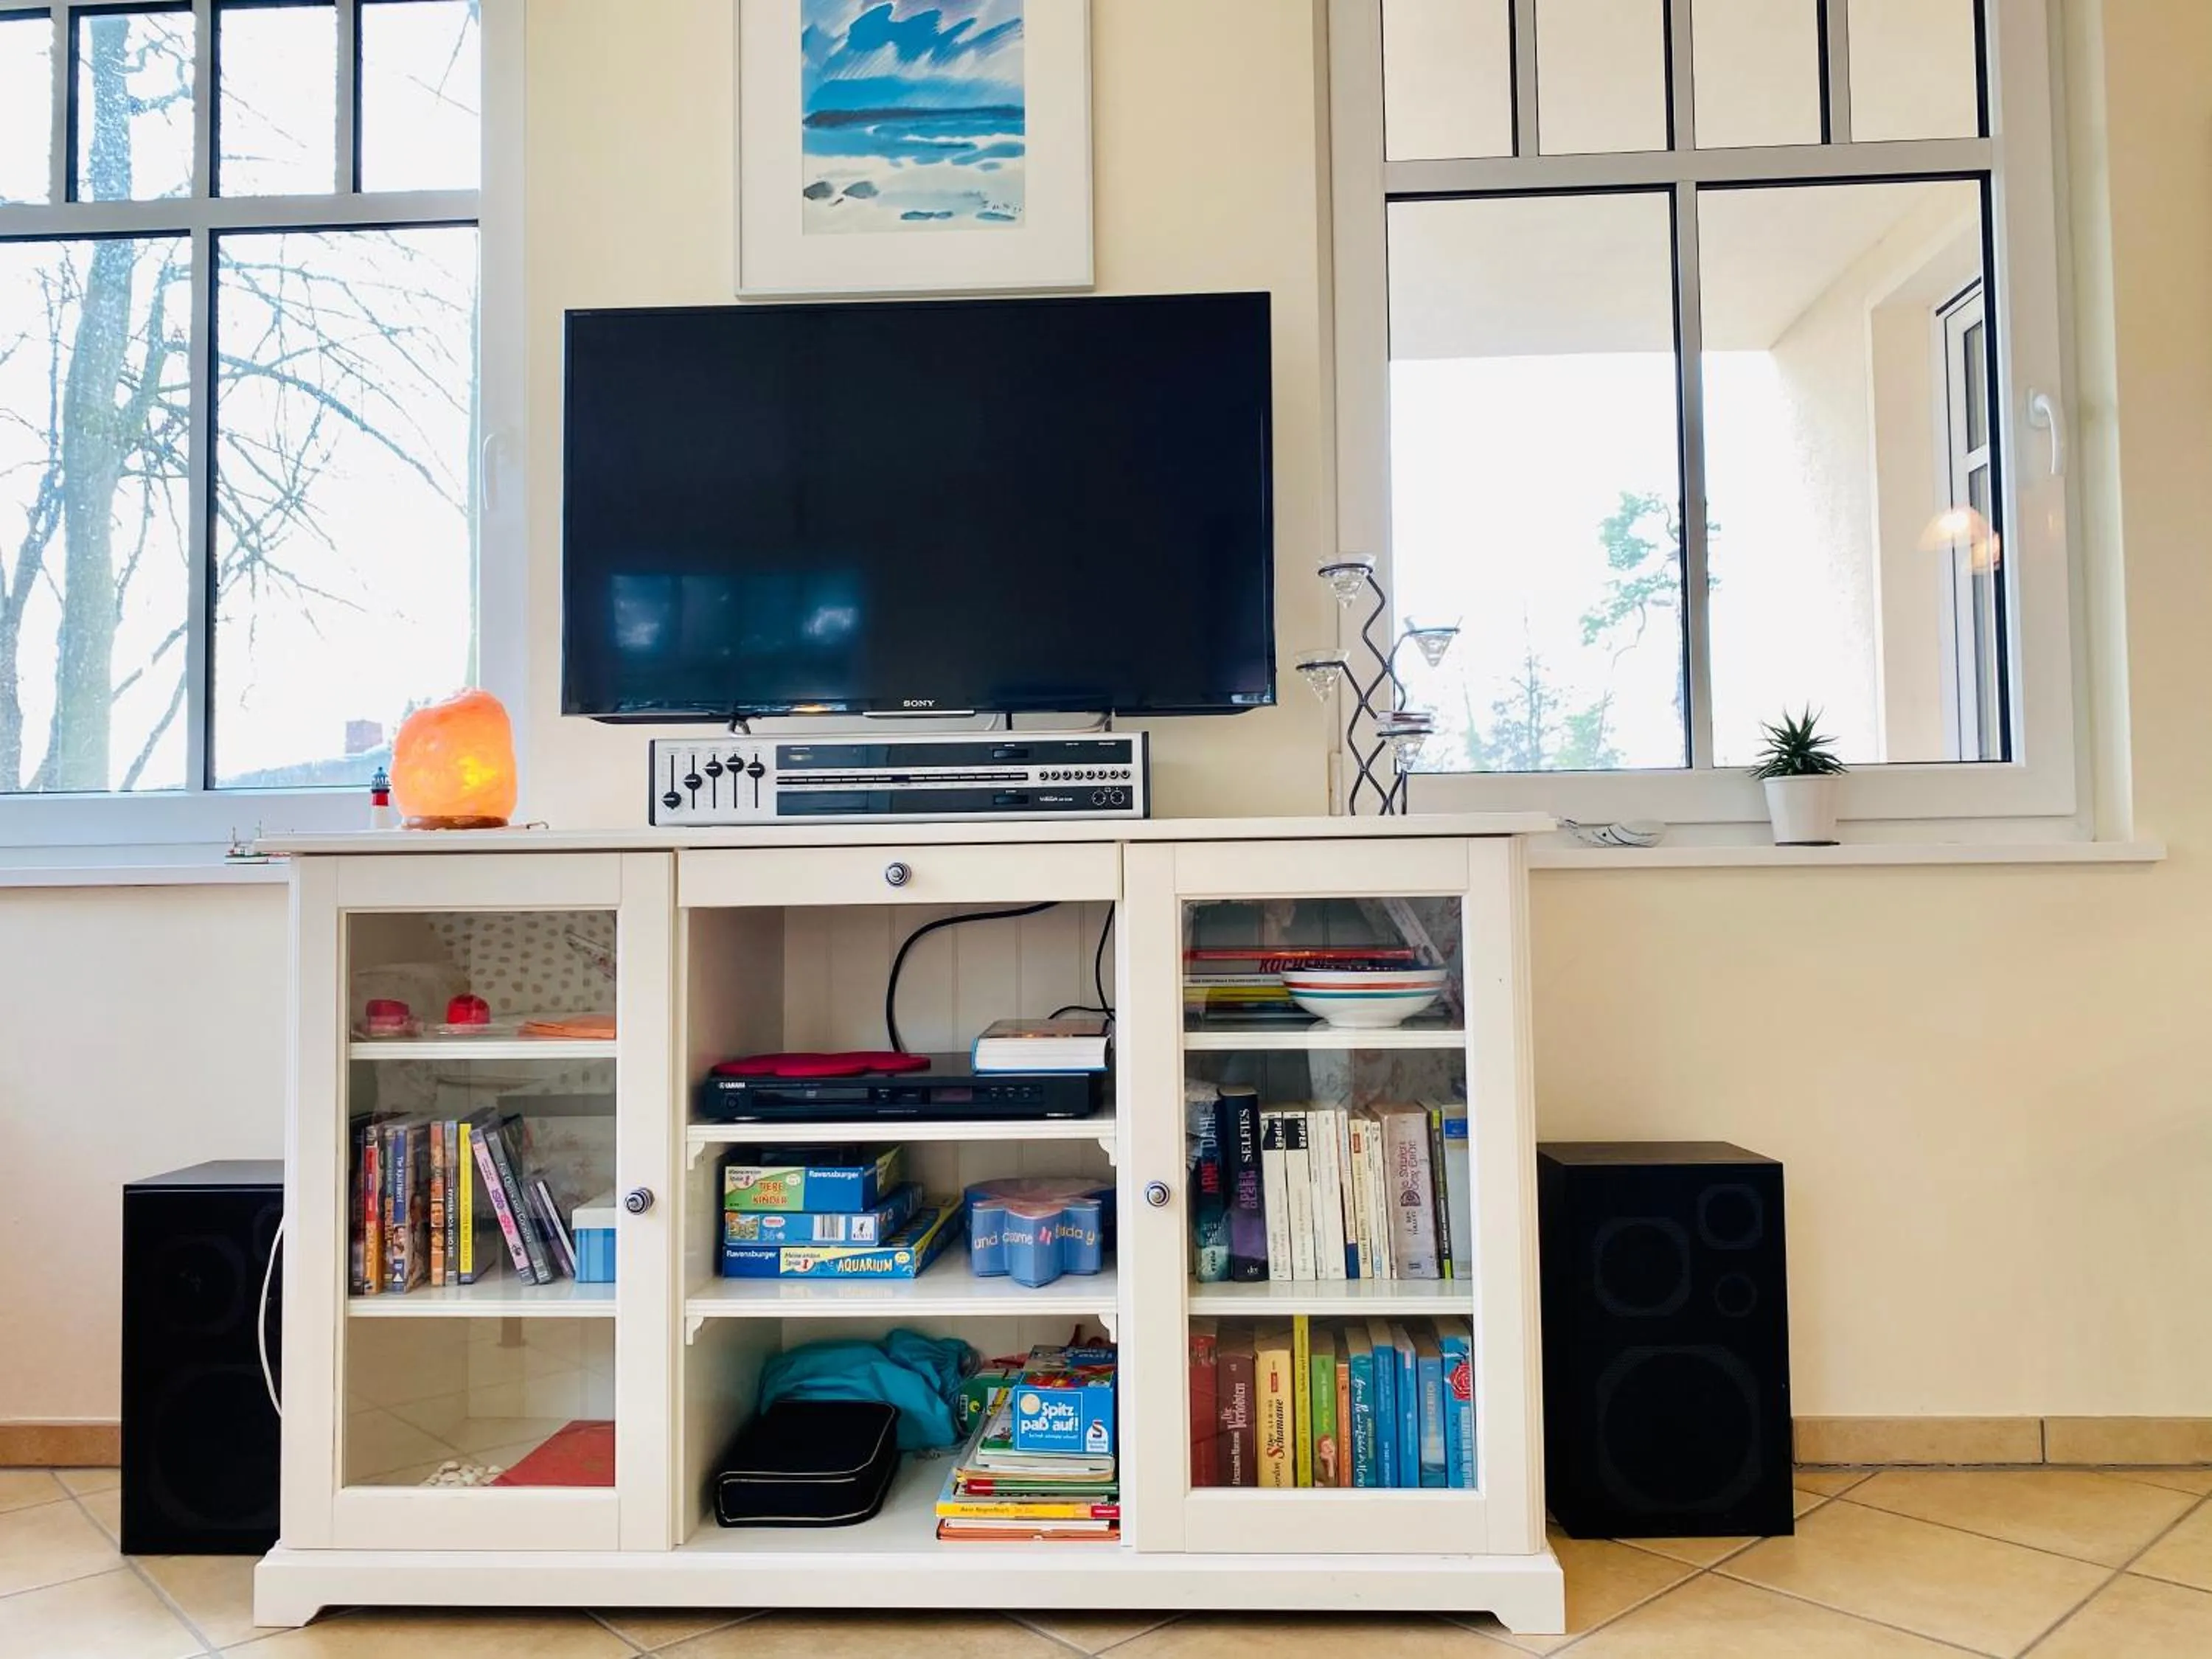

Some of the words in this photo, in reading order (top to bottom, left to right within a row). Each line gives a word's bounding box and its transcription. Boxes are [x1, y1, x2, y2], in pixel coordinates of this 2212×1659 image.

[1200, 1113, 1217, 1148] DAHL
[1240, 1108, 1252, 1163] SELFIES
[1273, 1119, 1284, 1149] PIPER
[1298, 1119, 1307, 1149] PIPER
[809, 1170, 859, 1180] Ravensburger
[726, 1250, 776, 1259] Ravensburger
[837, 1258, 893, 1273] AQUARIUM
[1041, 1402, 1074, 1419] Spitz
[1221, 1407, 1233, 1419] Die
[1227, 1382, 1247, 1429] Verlobten
[1020, 1416, 1049, 1433] paß
[1052, 1416, 1079, 1431] auf!
[1266, 1399, 1285, 1460] Schamane
